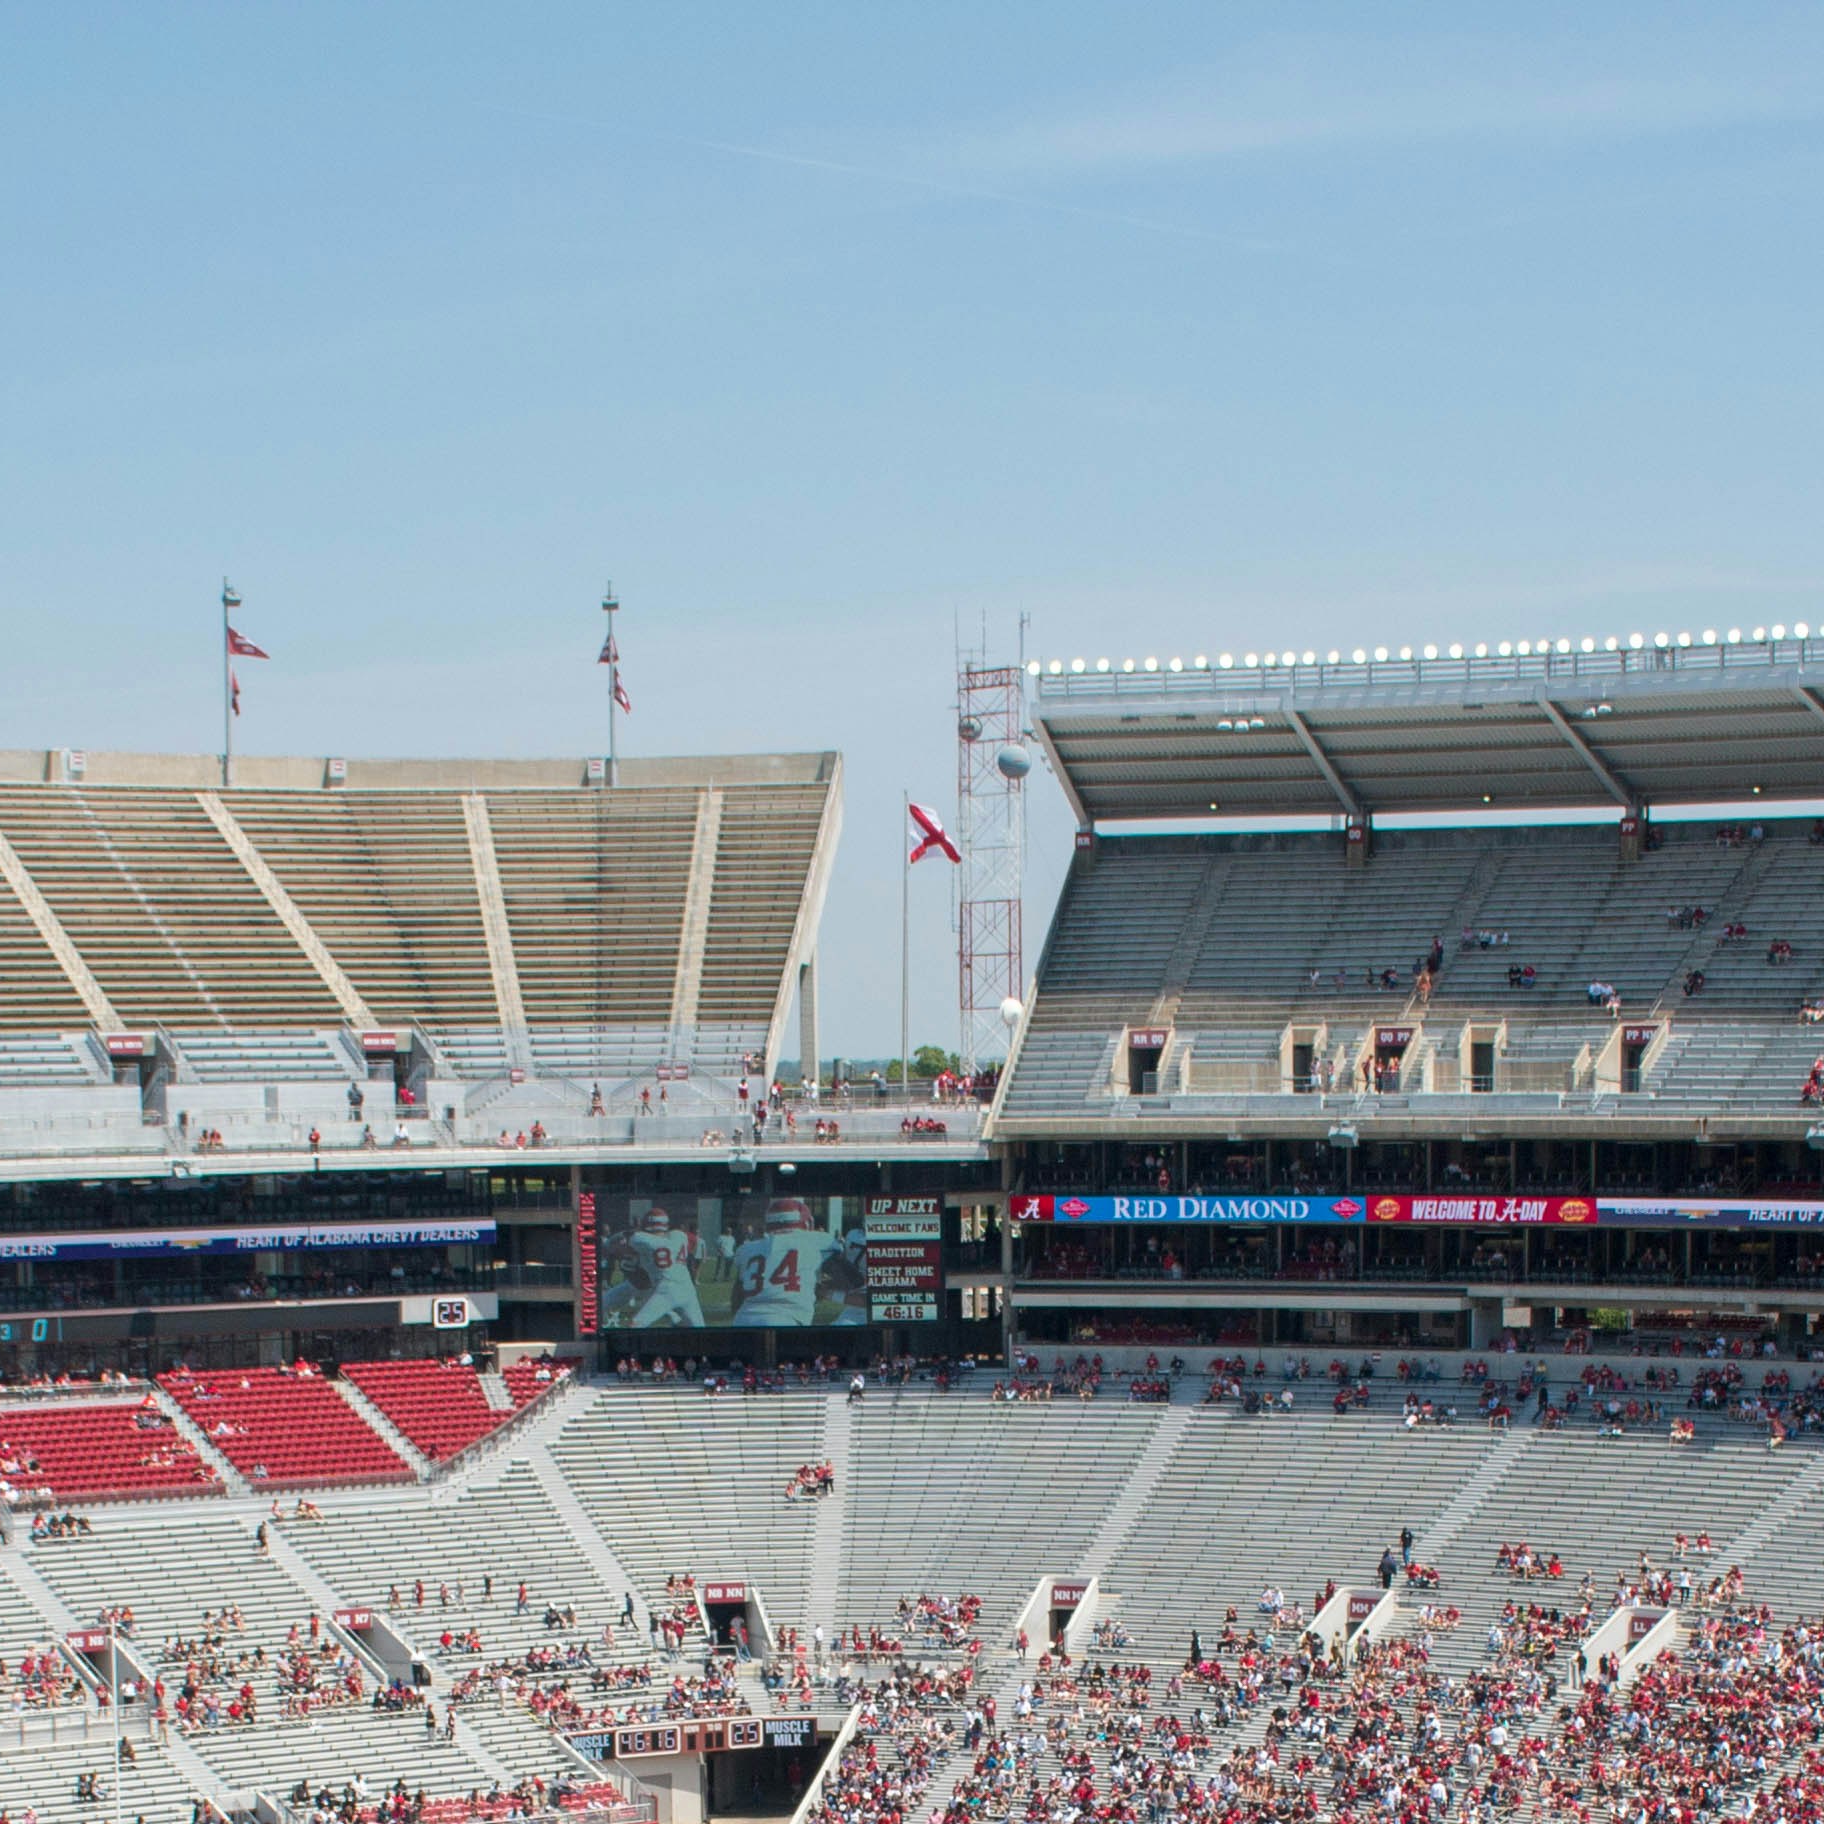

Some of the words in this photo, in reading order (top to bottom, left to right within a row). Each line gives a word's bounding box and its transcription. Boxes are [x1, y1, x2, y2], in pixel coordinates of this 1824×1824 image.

[871, 1199, 892, 1214] UP
[896, 1198, 937, 1213] NEXT
[1113, 1198, 1167, 1219] RED
[1178, 1198, 1309, 1219] DIAMOND
[1412, 1200, 1477, 1220] WELCOME
[1478, 1200, 1496, 1219] TO
[1748, 1209, 1793, 1221] HEART
[1797, 1210, 1816, 1221] OF
[867, 1223, 912, 1233] WELCOME
[915, 1223, 939, 1233] FANS
[236, 1235, 283, 1248] HEART
[285, 1234, 303, 1247] OF
[305, 1231, 371, 1246] ALABAMA
[373, 1229, 420, 1243] CHEVY
[421, 1228, 480, 1242] DEALERS
[867, 1248, 924, 1258] TRADITION
[743, 1249, 801, 1297] 34
[867, 1266, 902, 1276] SWEET
[905, 1266, 934, 1276] HOME
[868, 1277, 917, 1287] ALABAMA
[872, 1293, 898, 1303] GAME
[900, 1293, 923, 1303] TIME
[925, 1293, 935, 1303] IN
[440, 1303, 463, 1323] 25
[883, 1306, 924, 1319] 46:16
[0, 1324, 12, 1340] 3
[32, 1319, 49, 1342] 0
[735, 1724, 758, 1743] 25
[770, 1721, 814, 1734] MUSCLE
[620, 1730, 676, 1751] 46:16
[778, 1733, 806, 1746] MILK
